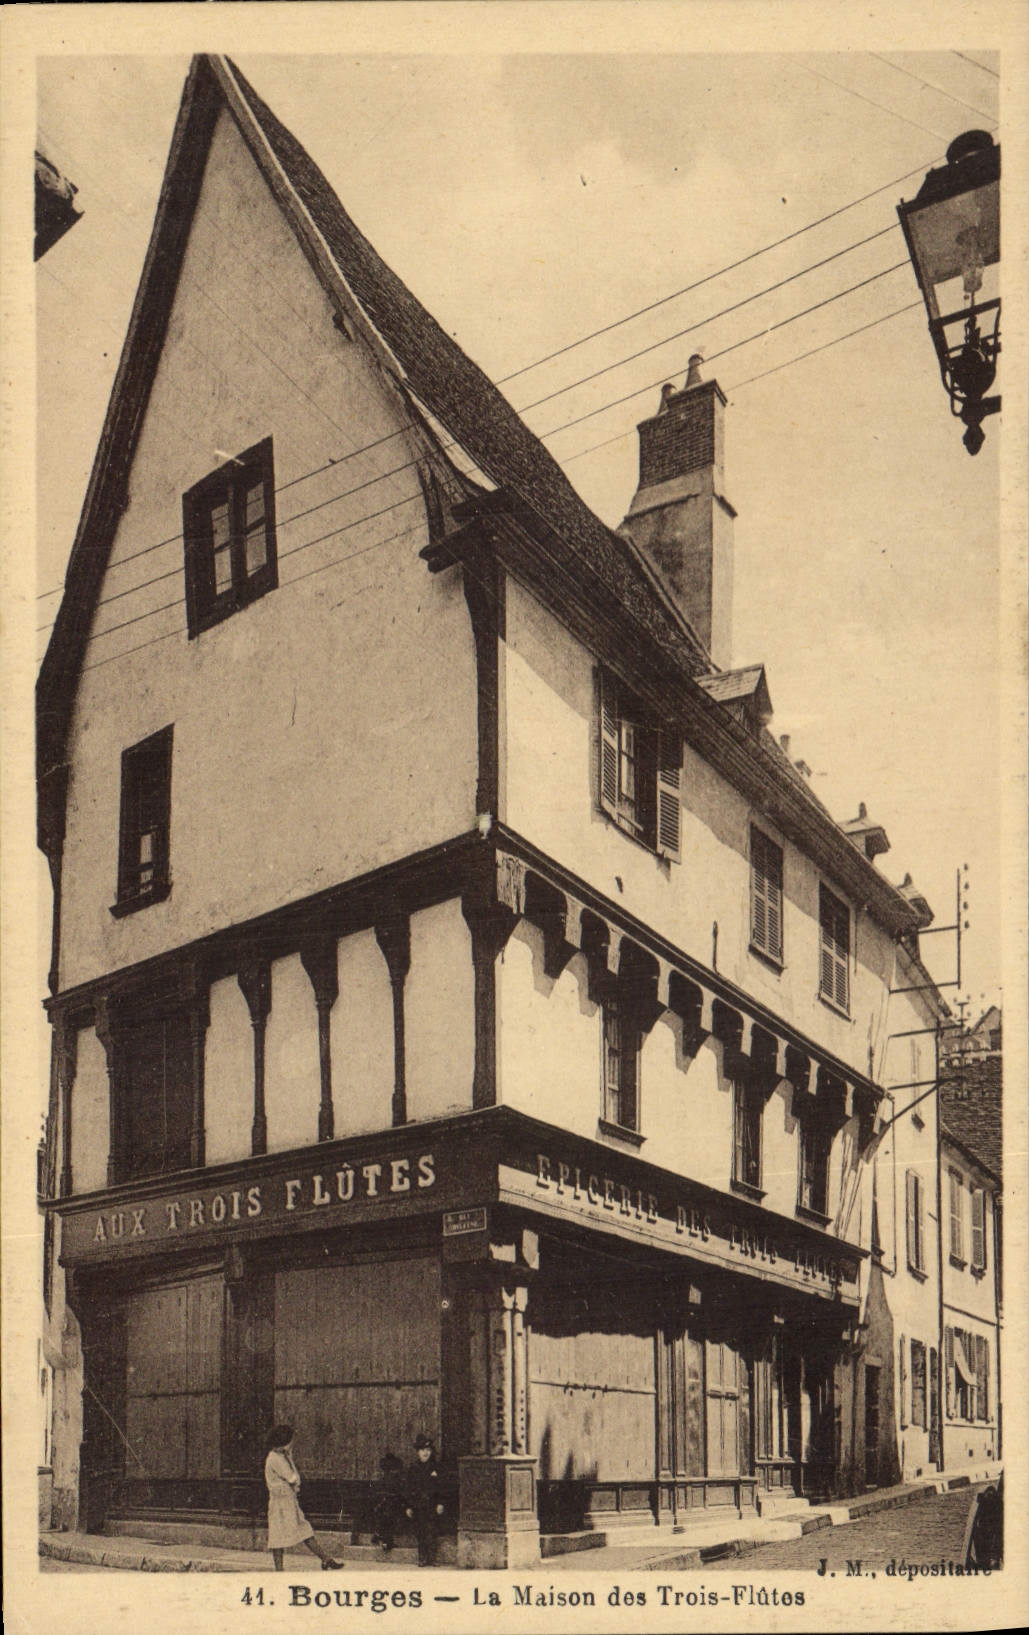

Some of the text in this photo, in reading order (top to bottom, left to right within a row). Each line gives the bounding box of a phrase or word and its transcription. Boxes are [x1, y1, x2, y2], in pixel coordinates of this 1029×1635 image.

[93, 1153, 436, 1243] AUX TROIS FLÛTES
